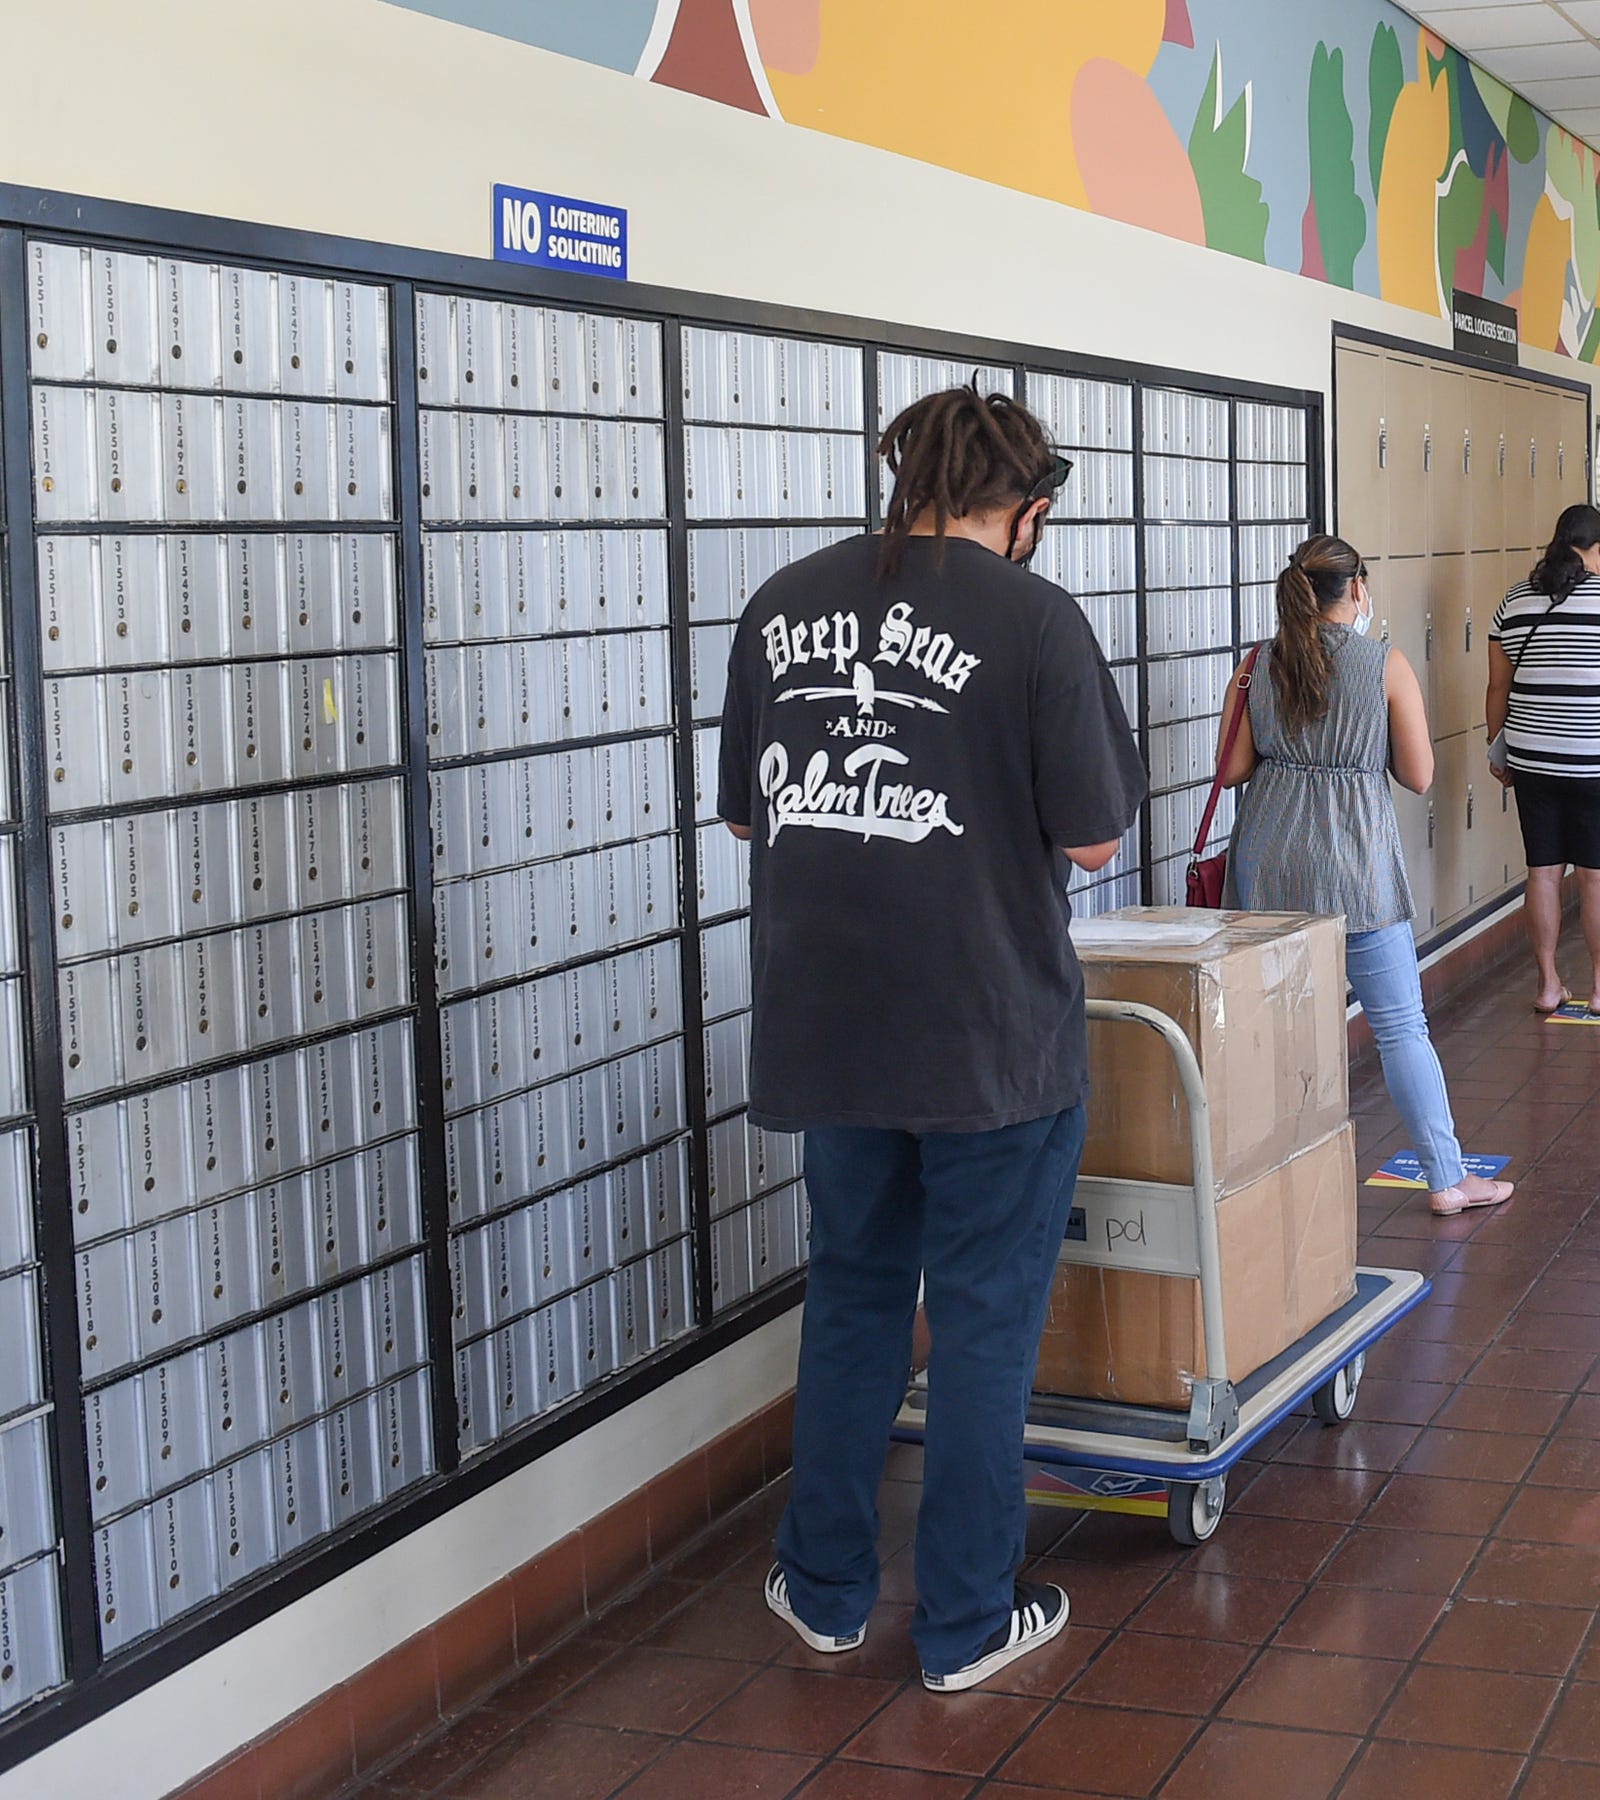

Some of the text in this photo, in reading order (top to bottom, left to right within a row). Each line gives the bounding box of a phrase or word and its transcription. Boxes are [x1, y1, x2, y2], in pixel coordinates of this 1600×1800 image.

[503, 198, 542, 254] NO
[548, 235, 622, 268] SOLICITING
[550, 205, 620, 239] LOITERING
[35, 247, 44, 328] 315511
[105, 257, 114, 336] 315501
[170, 265, 179, 341] 315491
[1454, 311, 1517, 345] PARCEL LOCKERS SECTION
[40, 392, 50, 473] 315512
[109, 396, 118, 474] 315502
[176, 399, 184, 475] 315492
[237, 403, 245, 477] 315482
[348, 408, 356, 478] 315462
[47, 542, 56, 622] 315513
[115, 541, 124, 618] 315503
[180, 540, 189, 615] 315493
[241, 539, 249, 612] 315483
[297, 539, 306, 610] 315473
[761, 610, 861, 683] Deep
[871, 601, 982, 694] Seas
[52, 683, 62, 762] 315514
[121, 677, 131, 755] 315504
[186, 674, 194, 748] 315494
[246, 667, 254, 740] 315484
[302, 664, 310, 734] 315474
[832, 718, 889, 738] AND
[307, 794, 315, 864] 315475
[361, 785, 369, 853] 315465
[759, 741, 857, 848] Palm
[843, 743, 964, 840] Trees
[58, 832, 70, 911] 315515
[128, 820, 136, 897] 315505
[192, 811, 200, 886] 315495
[251, 802, 260, 874] 315485
[256, 929, 265, 1001] 315486
[312, 918, 321, 987] 315476
[365, 906, 373, 974] 315466
[67, 970, 77, 1049] 315516
[133, 956, 144, 1032] 315506
[197, 942, 206, 1016] 315496
[263, 1064, 272, 1135] 315487
[319, 1046, 329, 1117] 315477
[371, 1032, 379, 1099] 315467
[142, 1098, 152, 1174] 315507
[204, 1079, 214, 1152] 315497
[76, 1117, 86, 1196] 315517
[376, 1149, 384, 1216] 315468
[270, 1188, 278, 1258] 315488
[325, 1168, 333, 1237] 315478
[150, 1230, 159, 1305] 315508
[212, 1208, 221, 1282] 315498
[83, 1254, 93, 1331] 315518
[332, 1294, 341, 1363] 315479
[219, 1341, 229, 1413] 315499
[277, 1317, 287, 1386] 315489
[93, 1395, 104, 1472] 315519
[159, 1368, 168, 1442] 315509
[390, 1387, 398, 1453] 315470
[285, 1439, 294, 1508] 315490
[338, 1413, 347, 1480] 315480
[167, 1498, 177, 1571] 315510
[227, 1468, 237, 1539] 315500
[102, 1529, 114, 1604] 315520
[0, 1581, 11, 1660] 315530
